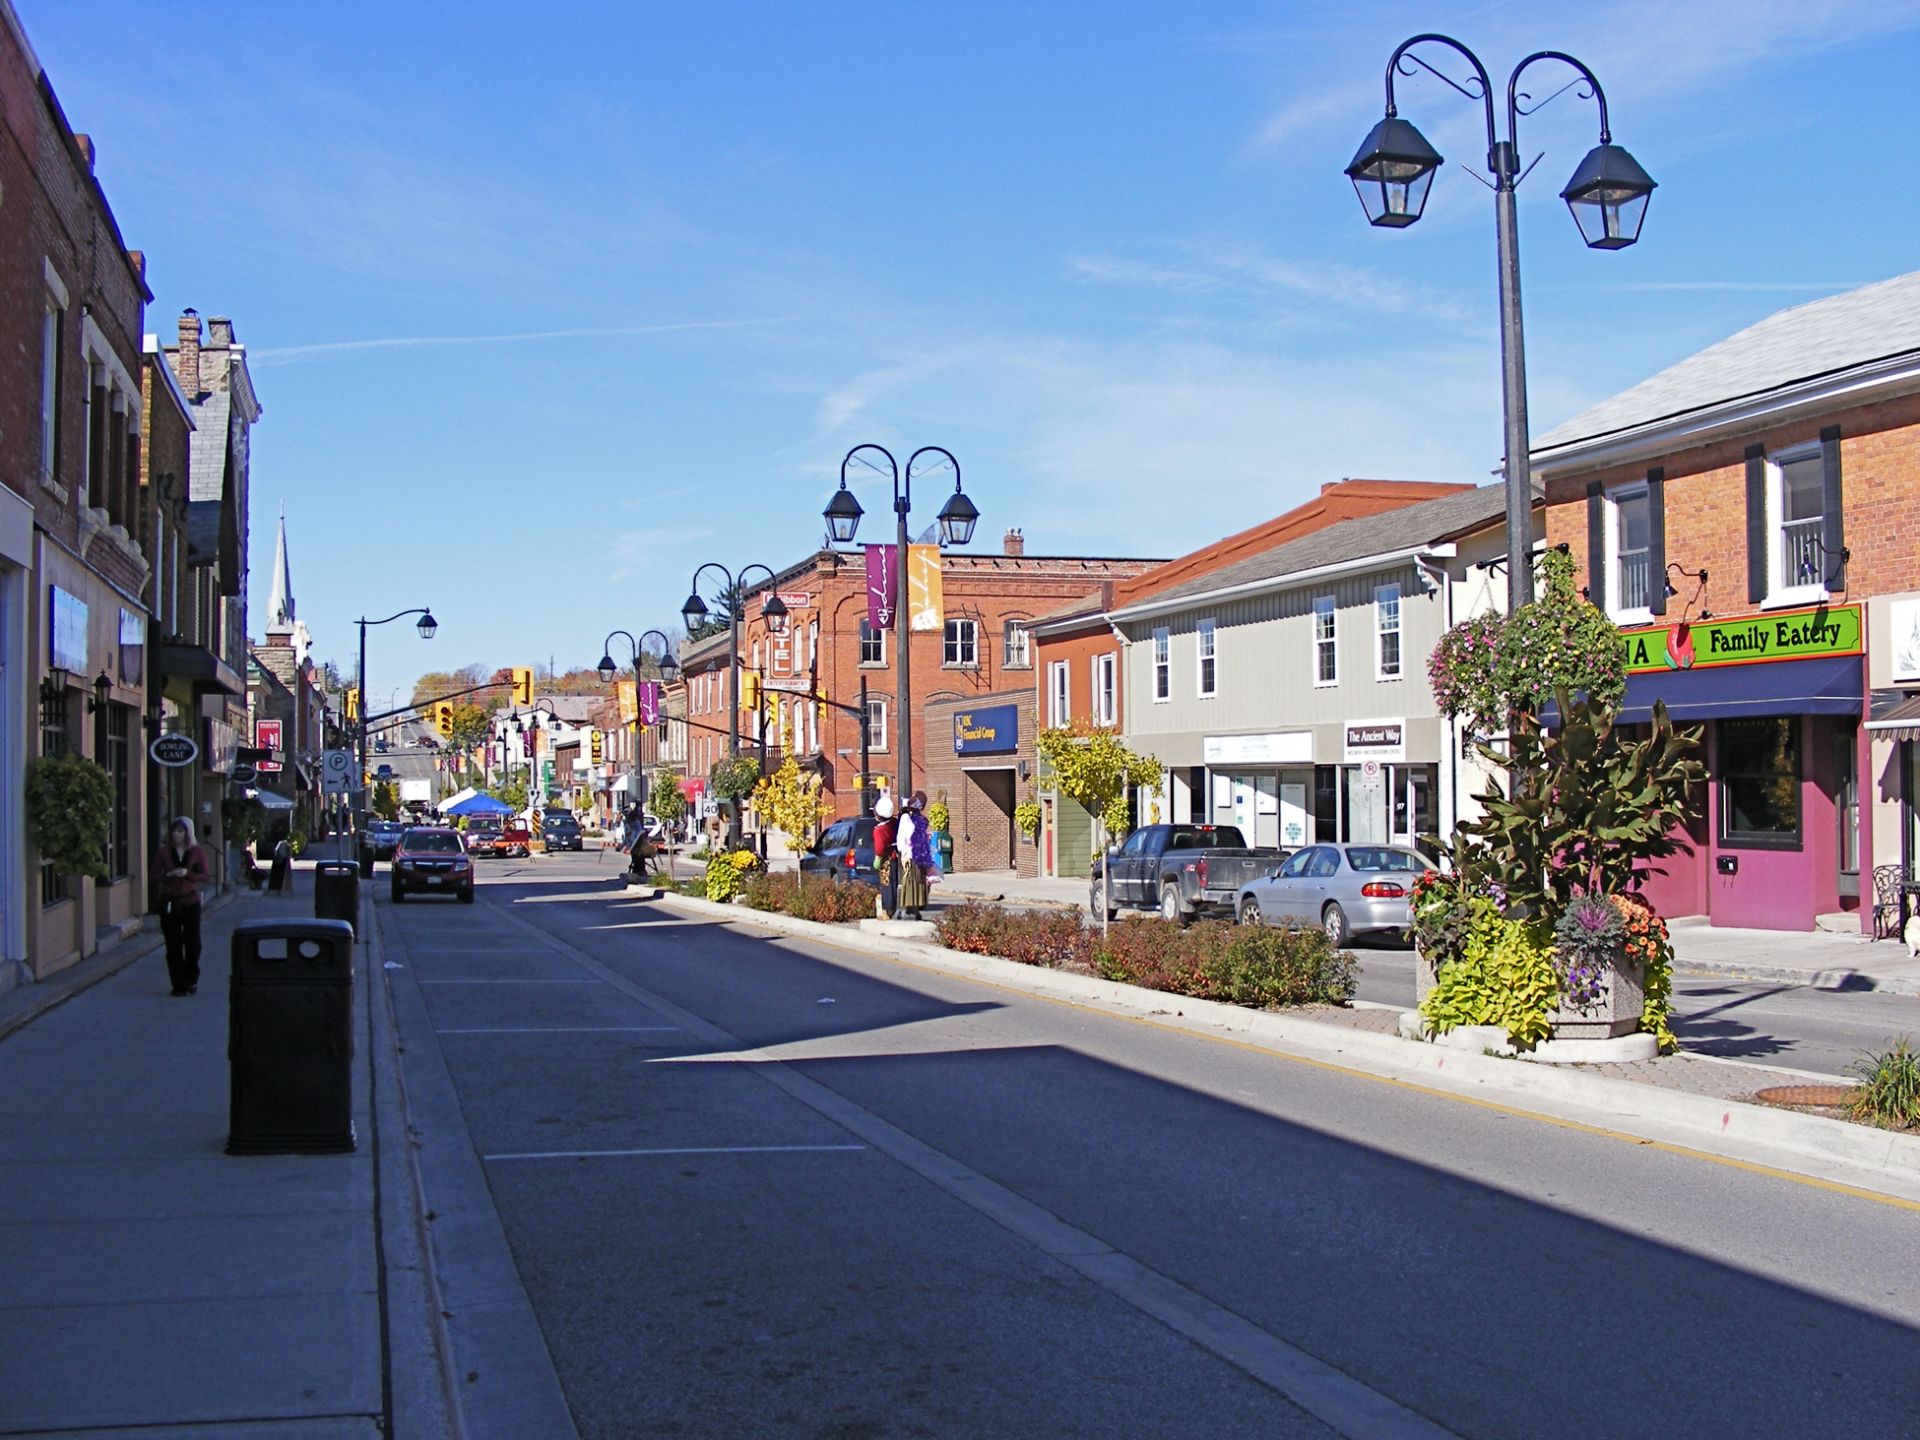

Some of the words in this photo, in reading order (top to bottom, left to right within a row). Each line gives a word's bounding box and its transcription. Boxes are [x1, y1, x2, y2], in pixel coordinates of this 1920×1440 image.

[1710, 627, 1769, 654] Family
[1776, 621, 1841, 648] Eatery
[1348, 730, 1360, 743] The
[1361, 729, 1385, 742] Ancient
[1385, 728, 1400, 744] Way
[163, 750, 186, 759] LANE
[704, 805, 718, 814] 40
[1396, 802, 1405, 811] 97
